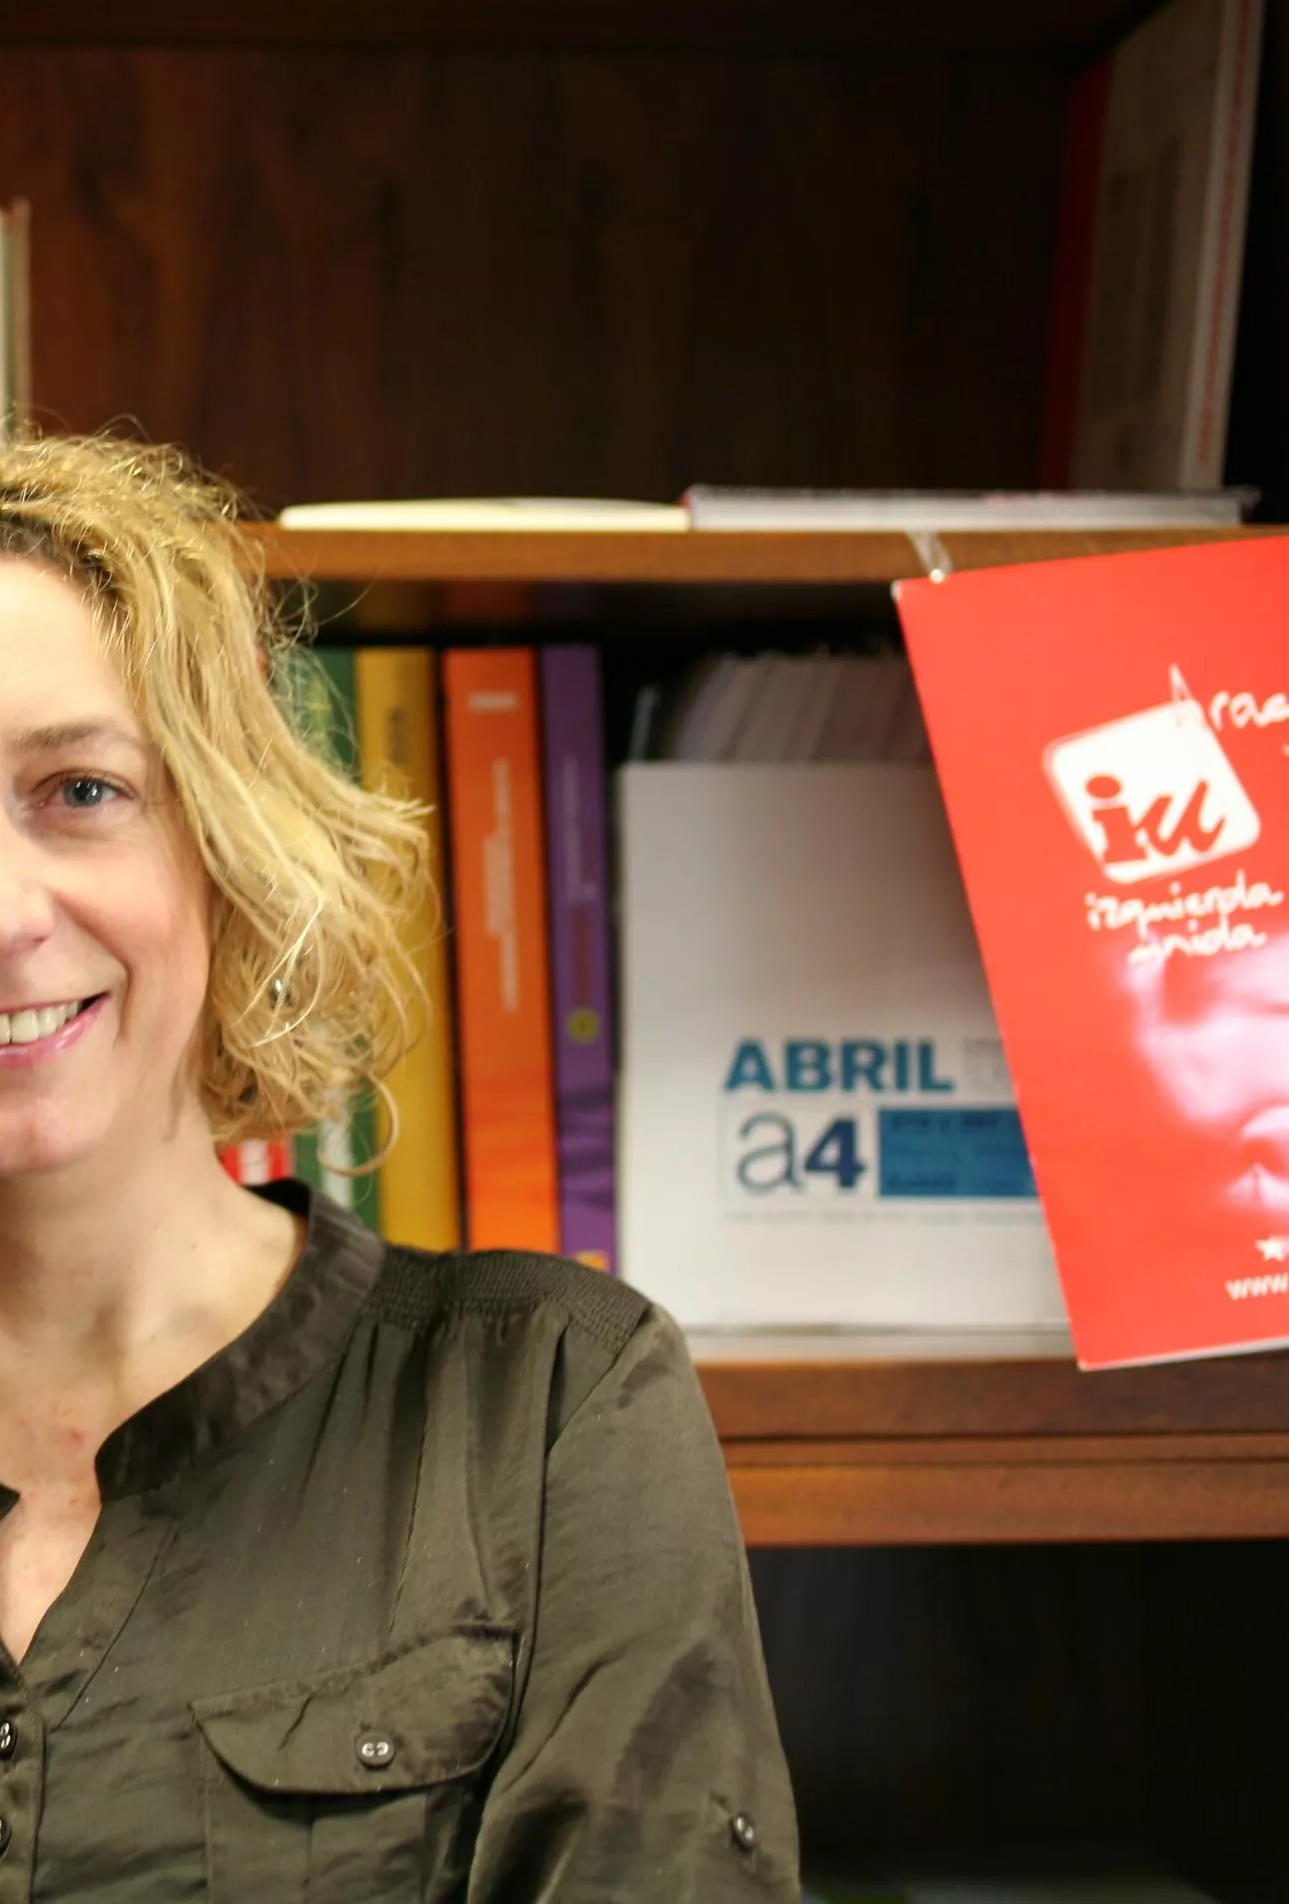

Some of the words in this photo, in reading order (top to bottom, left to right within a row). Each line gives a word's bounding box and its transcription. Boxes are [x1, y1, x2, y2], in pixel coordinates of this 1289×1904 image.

[1083, 869, 1285, 940] izquierda
[724, 1038, 955, 1092] ABRIL
[736, 1111, 866, 1194] a4
